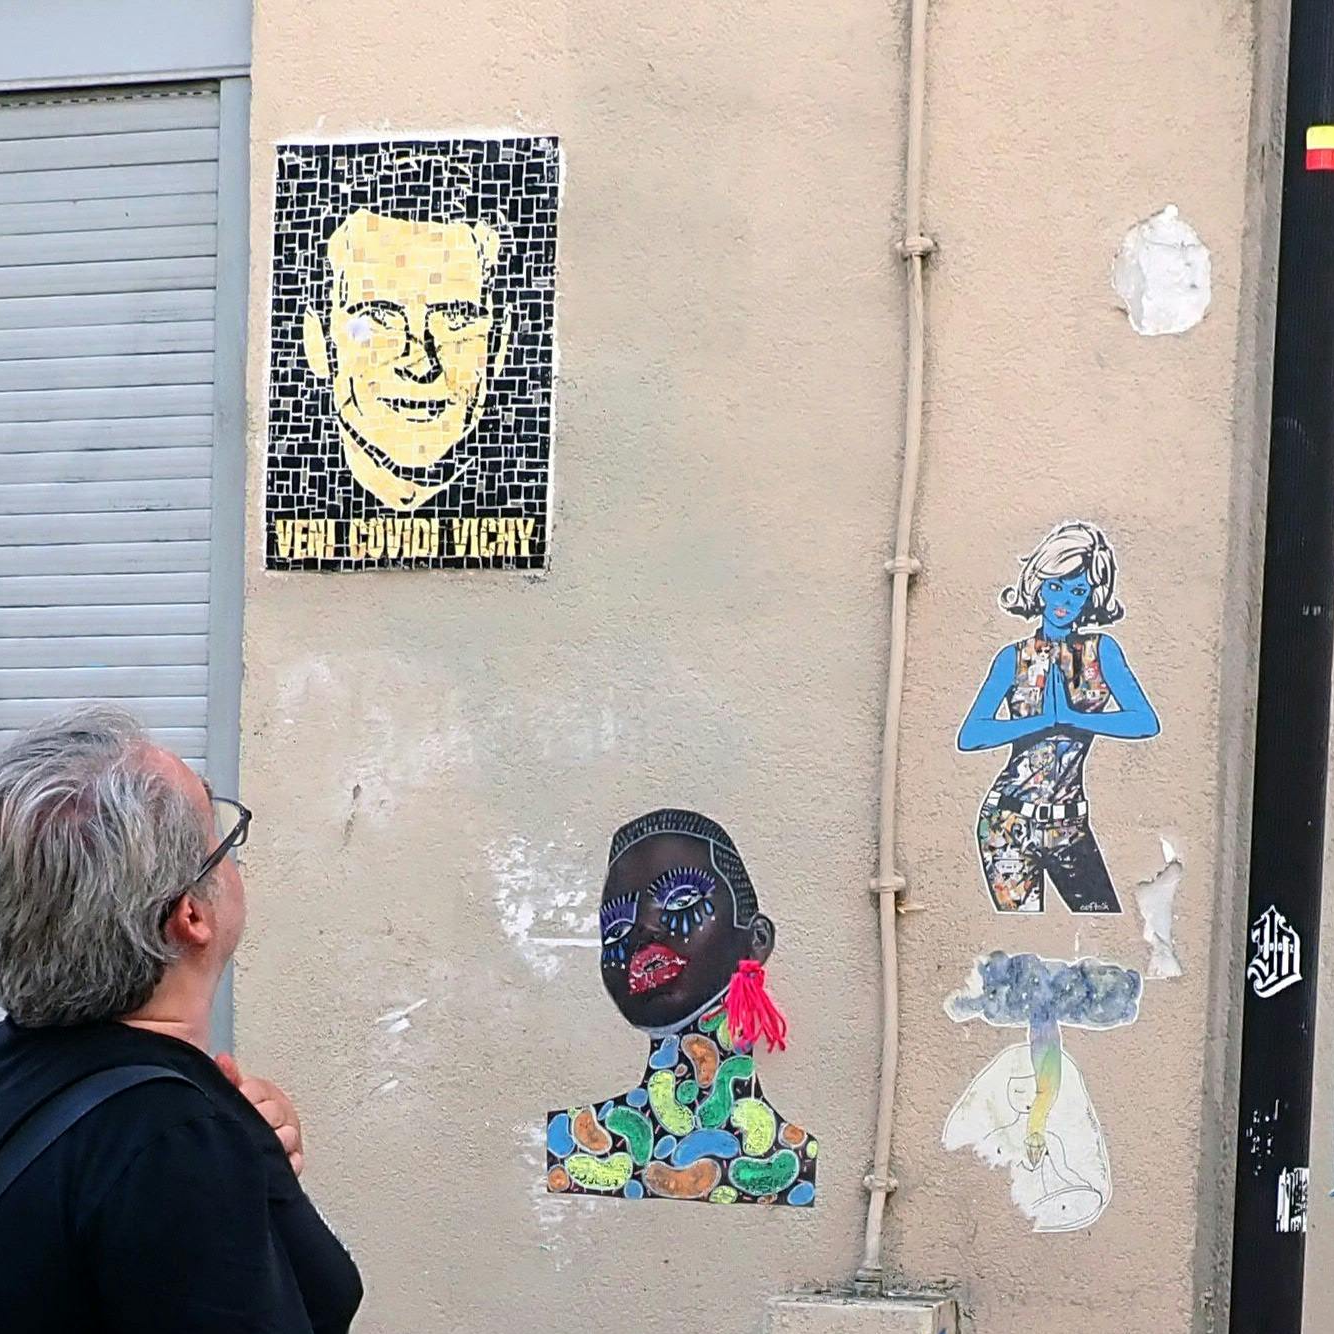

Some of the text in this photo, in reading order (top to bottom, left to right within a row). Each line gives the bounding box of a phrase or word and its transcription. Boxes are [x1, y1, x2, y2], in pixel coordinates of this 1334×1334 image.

[276, 517, 536, 560] VENI COVIDI VICHY
